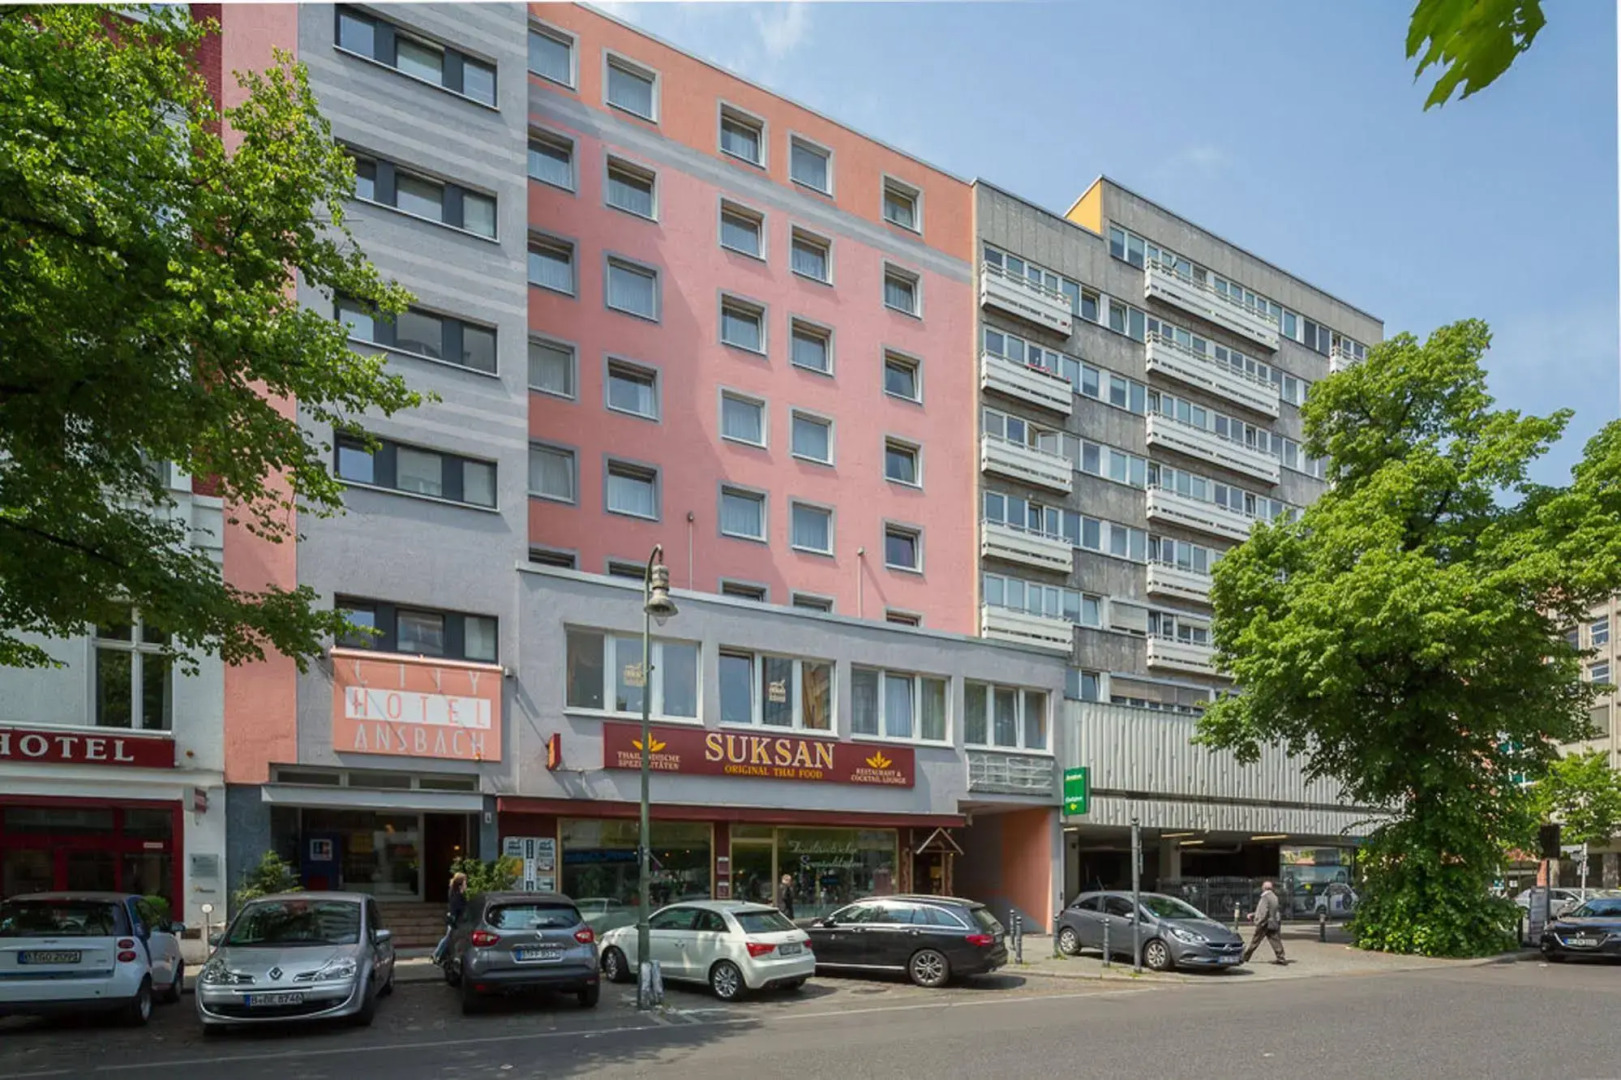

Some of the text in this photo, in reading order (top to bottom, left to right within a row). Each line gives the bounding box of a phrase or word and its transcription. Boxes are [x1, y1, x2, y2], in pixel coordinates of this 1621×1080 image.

[352, 688, 485, 727] HOTEL
[354, 723, 486, 756] ANSBACH
[705, 732, 835, 770] SUKSAN
[617, 750, 680, 762] THAILDISCHE
[618, 759, 679, 770] SPEZIITÄTEN
[724, 763, 769, 777] ORIGINAL
[799, 769, 823, 780] FOOD
